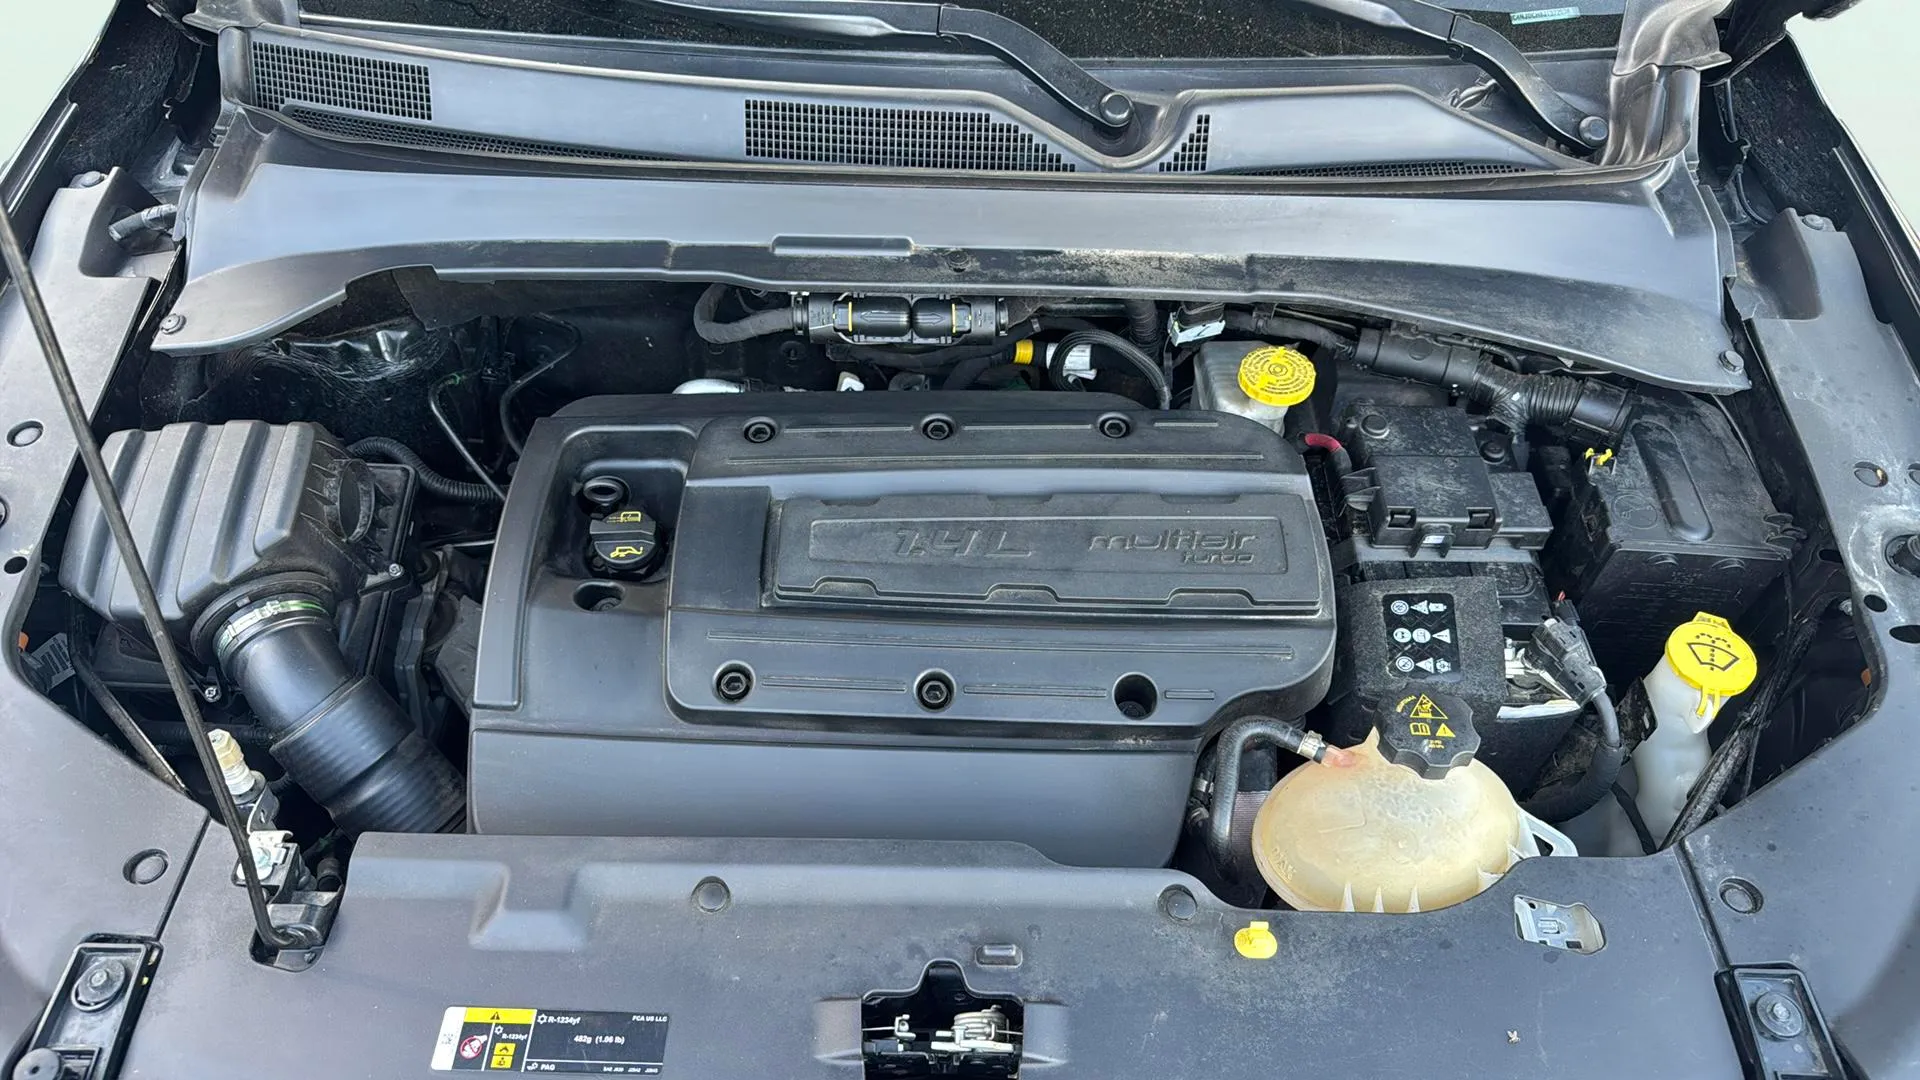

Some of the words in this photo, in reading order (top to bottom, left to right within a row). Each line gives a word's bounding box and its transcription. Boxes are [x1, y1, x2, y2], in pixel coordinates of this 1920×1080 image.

[1087, 527, 1257, 551] multiair
[1182, 551, 1256, 565] turbo
[547, 1015, 581, 1026] R-1234yf
